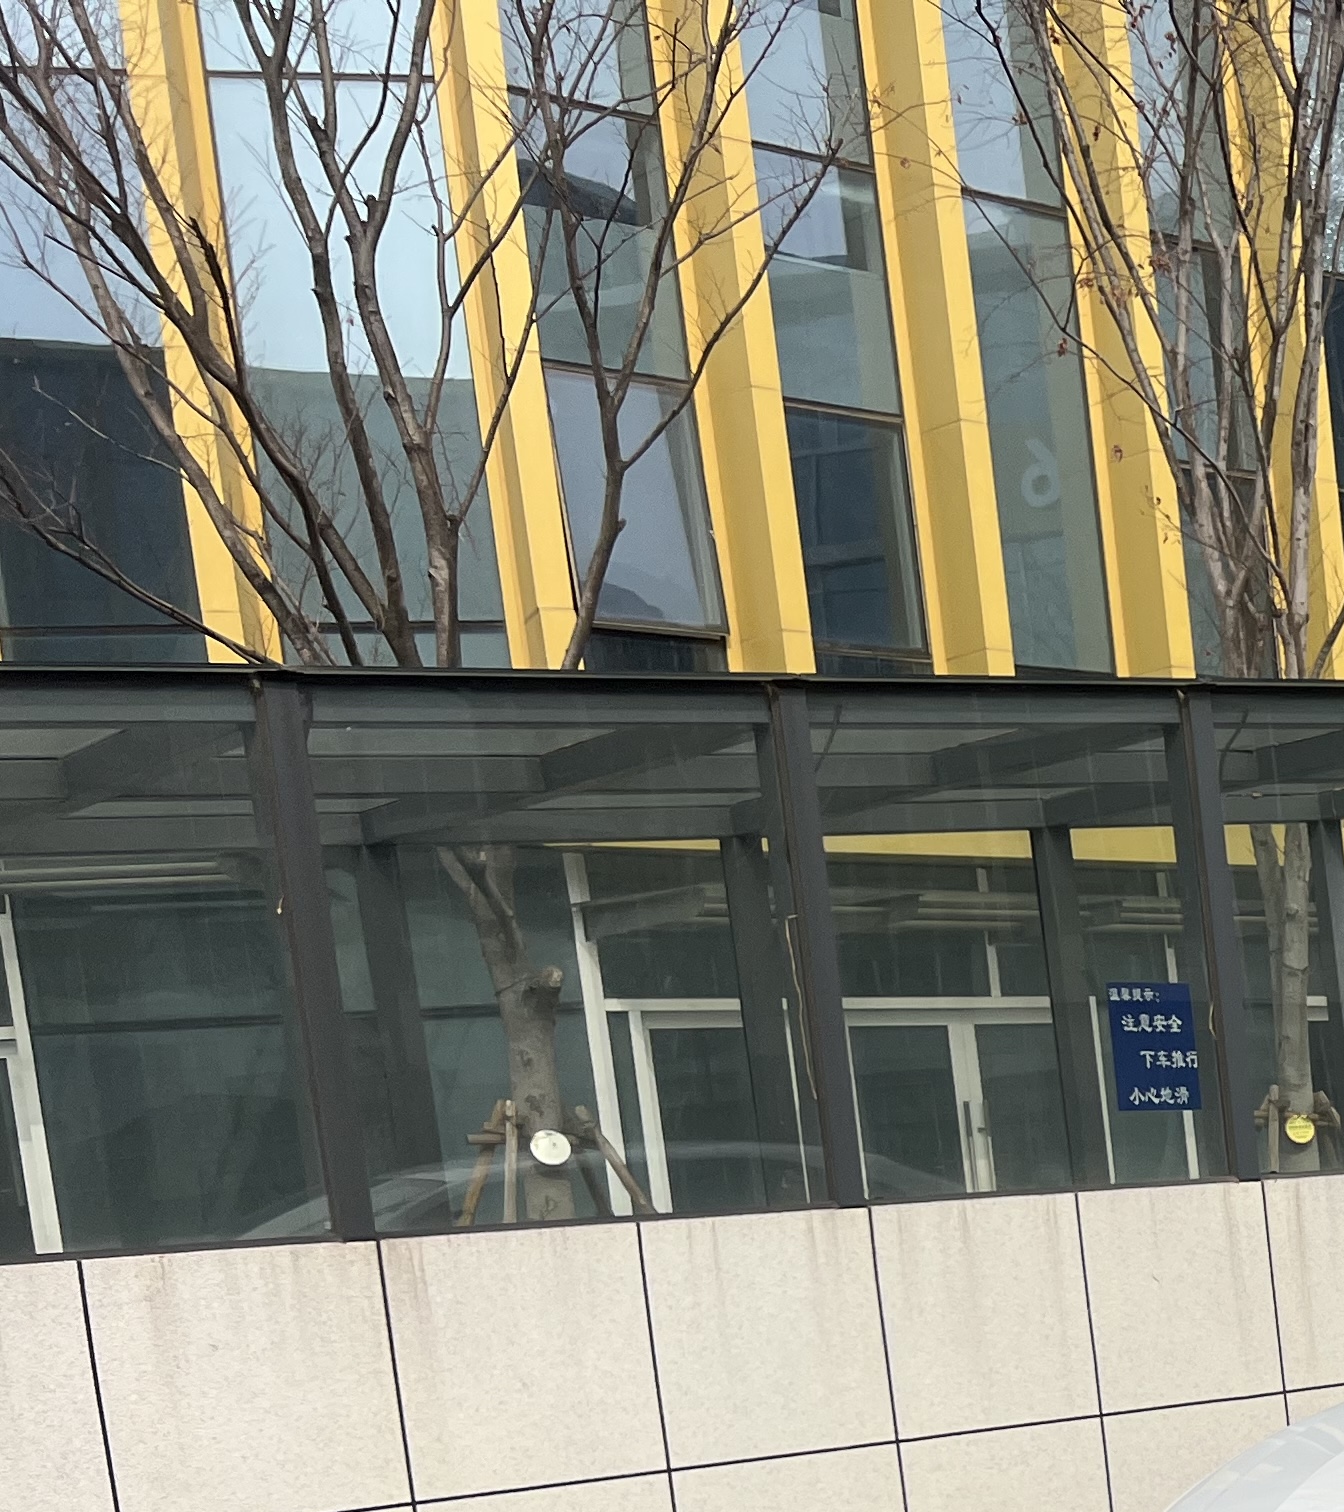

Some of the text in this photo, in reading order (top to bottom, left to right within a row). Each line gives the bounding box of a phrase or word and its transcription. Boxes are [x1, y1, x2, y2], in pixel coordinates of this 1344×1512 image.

[1121, 1013, 1183, 1033] 注意安全
[1139, 1050, 1199, 1069] 下车推行
[1128, 1086, 1190, 1106] 小心地滑
